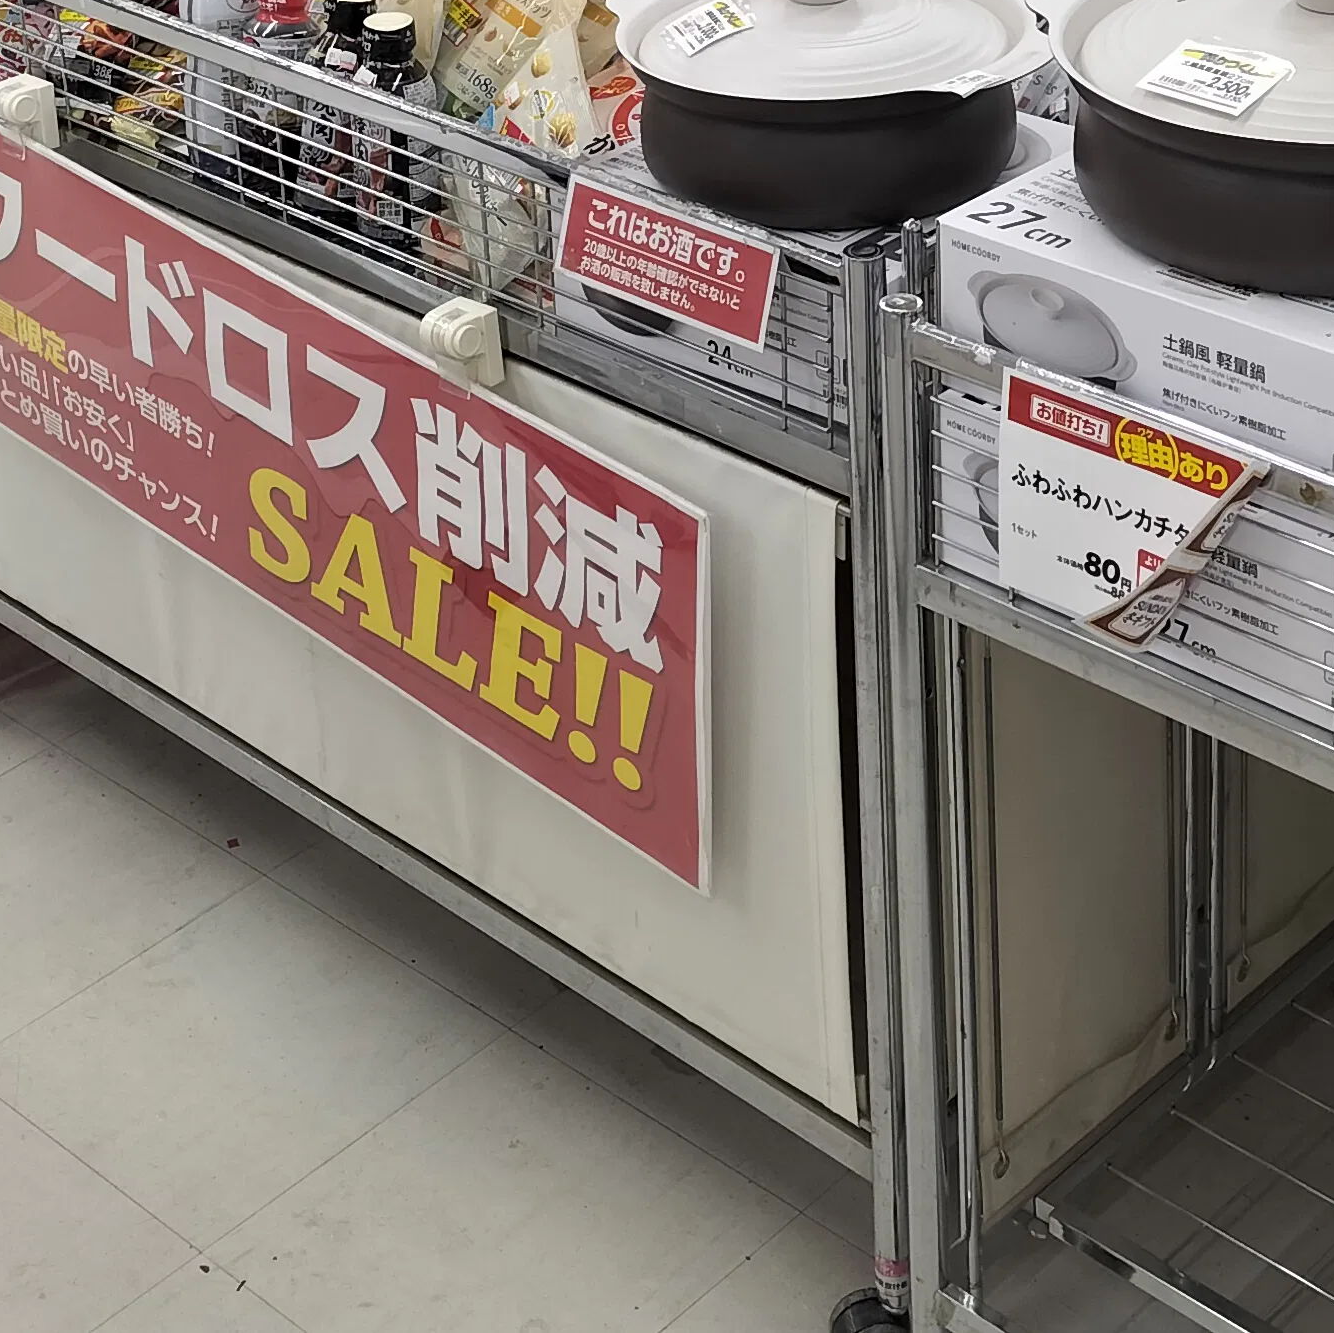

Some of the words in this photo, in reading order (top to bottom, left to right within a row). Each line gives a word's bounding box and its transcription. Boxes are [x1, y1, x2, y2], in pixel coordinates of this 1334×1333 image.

[467, 66, 499, 100] 168g
[1206, 77, 1251, 98] 2,500円
[587, 197, 745, 284] これはお酒です。
[580, 254, 696, 313] お酒の販売を致しません。
[583, 238, 741, 311] 20歳以上の年齢確認ができないと
[1163, 334, 1210, 363] 土鍋風
[1217, 351, 1265, 383] 軽量鍋
[1163, 388, 1286, 440] 焦げ付きにくいフッ素樹脂加工
[1037, 402, 1105, 440] お値打ち!
[1119, 432, 1229, 491] 理由あり
[1012, 523, 1037, 539] 1セット
[1083, 551, 1132, 590] 80円
[248, 466, 655, 793] SALE!!
